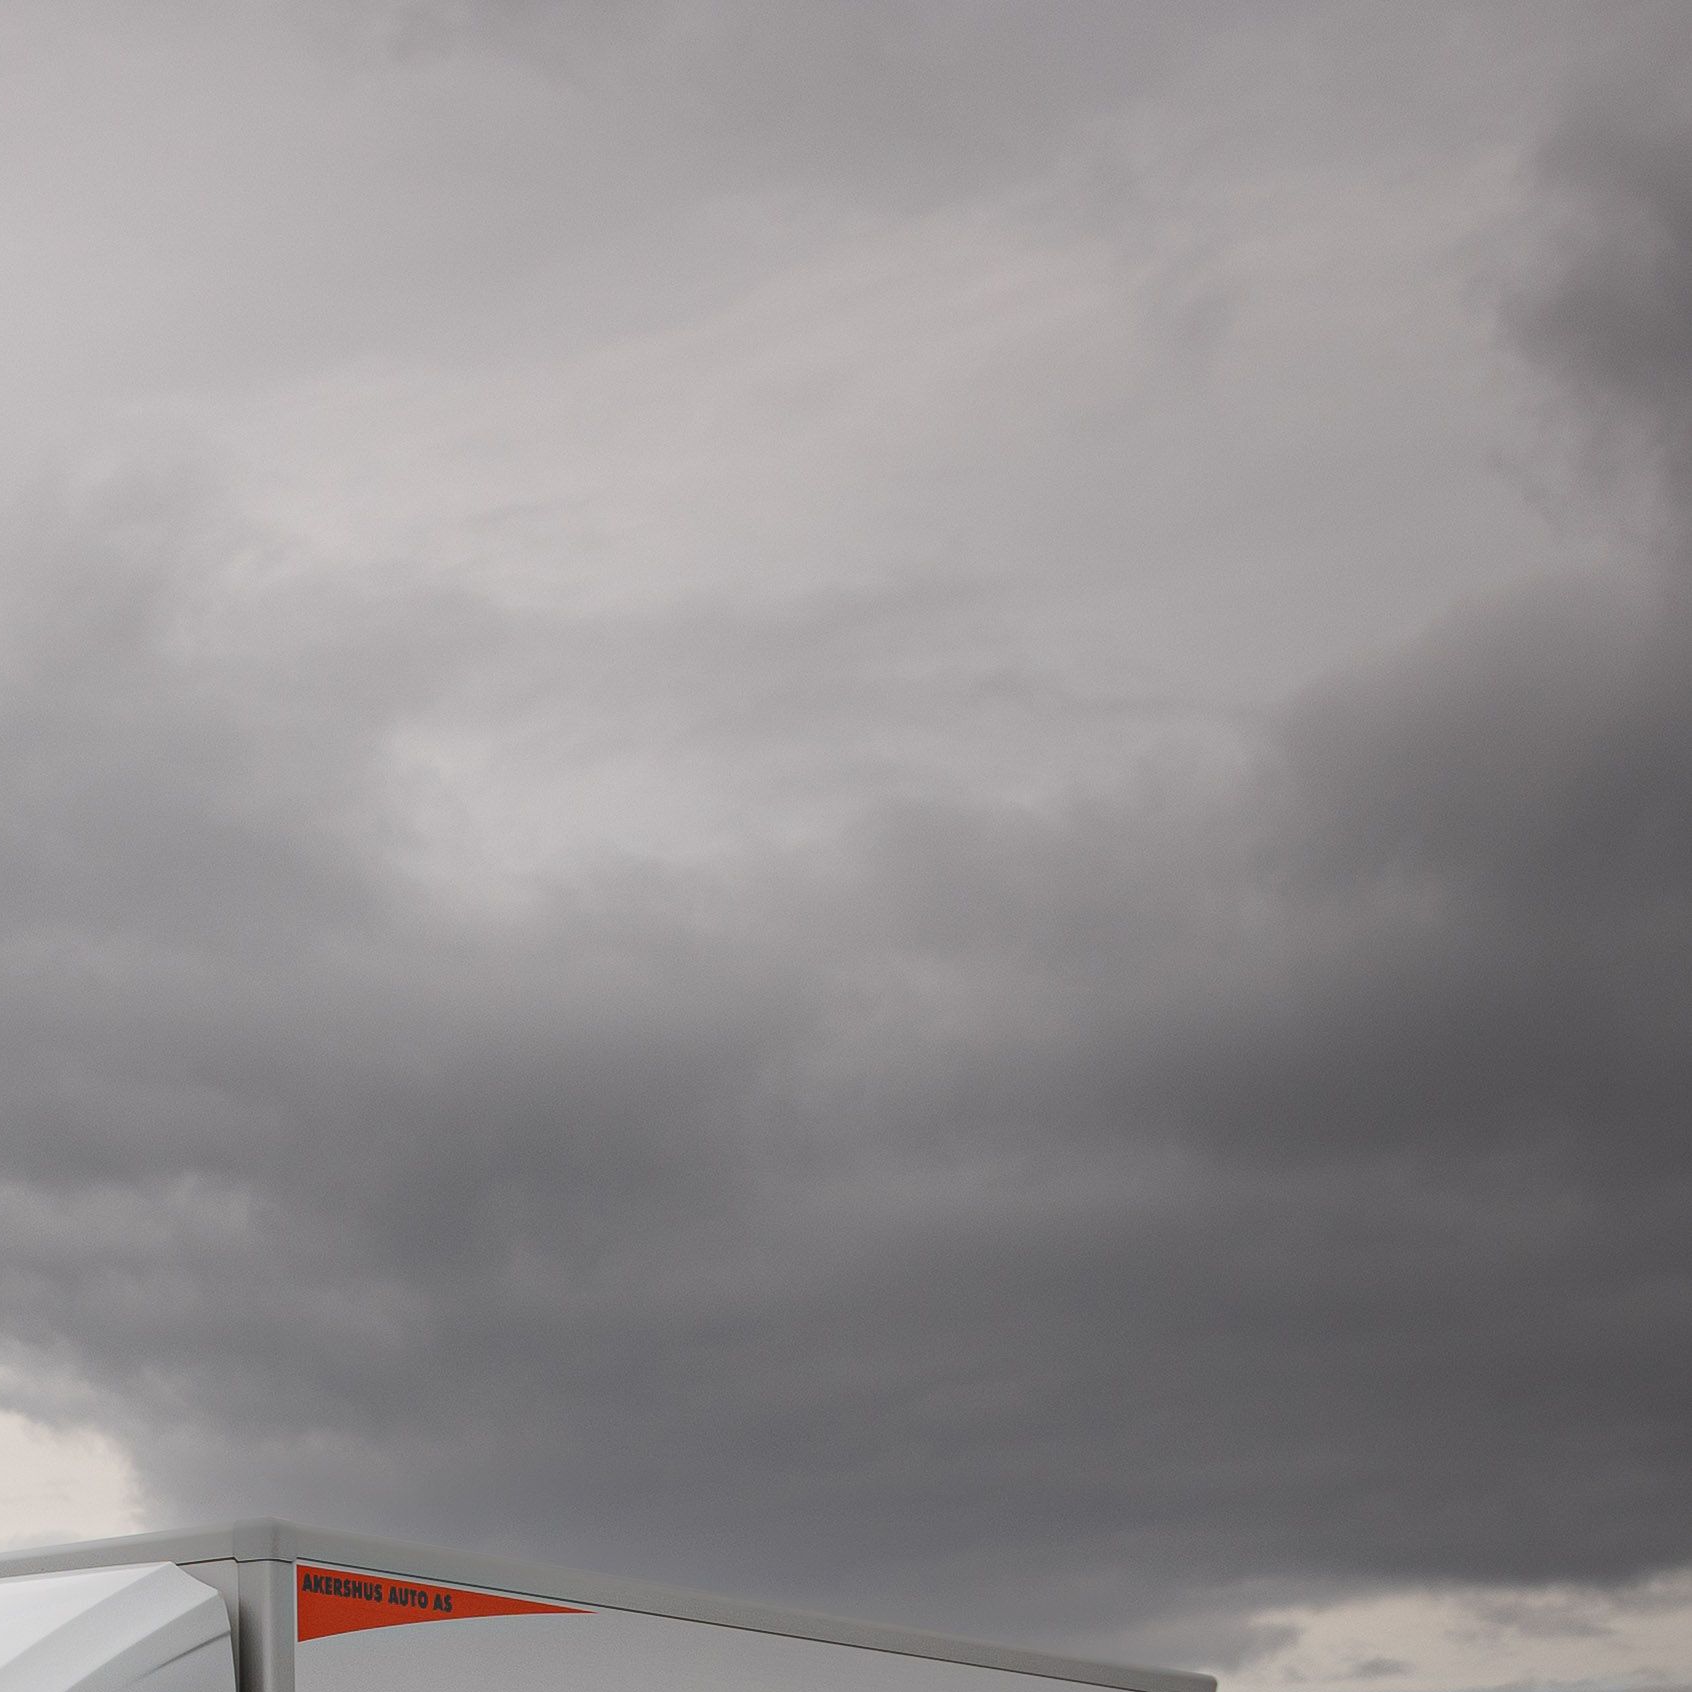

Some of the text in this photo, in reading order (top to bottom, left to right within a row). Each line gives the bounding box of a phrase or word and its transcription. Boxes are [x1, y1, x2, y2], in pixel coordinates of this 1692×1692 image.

[302, 1573, 452, 1612] AKERSHUS AUTO AS
